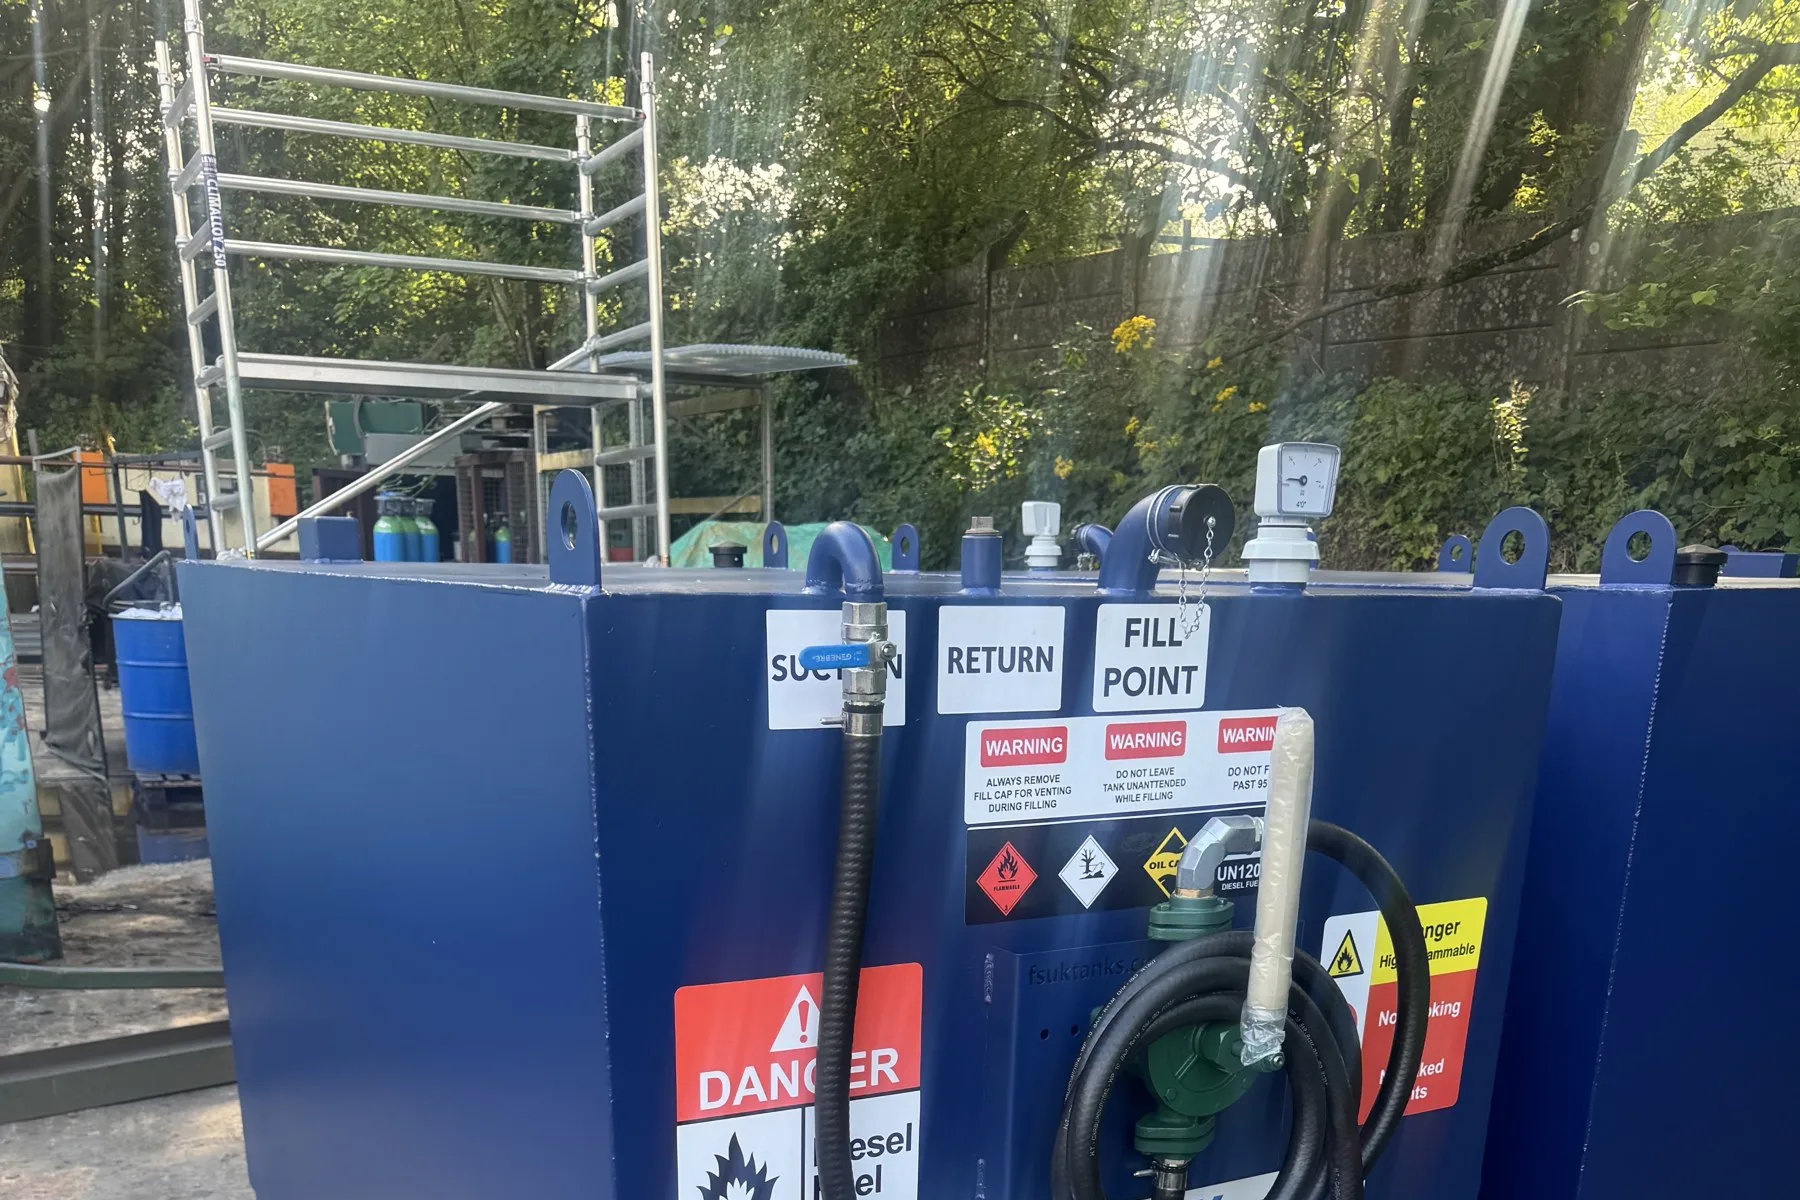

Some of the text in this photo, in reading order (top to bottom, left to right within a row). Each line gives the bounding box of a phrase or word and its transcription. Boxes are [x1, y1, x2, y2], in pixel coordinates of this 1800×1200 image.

[206, 179, 224, 242] CLIMALLOY
[213, 244, 226, 267] 250
[1124, 617, 1182, 648] FILL
[948, 645, 1054, 675] RETURN
[1103, 665, 1199, 698] POINT
[1110, 730, 1182, 750] WARNING
[1222, 726, 1276, 743] WARNIN
[985, 737, 1063, 757] WARNING
[986, 774, 1060, 787] ALWAYS REMOVE
[1116, 767, 1175, 779] DO NOT LEAVE
[1228, 766, 1241, 777] DO
[1243, 765, 1262, 775] NOT
[974, 786, 1072, 800] FILL CAP FOR VENTING
[1103, 782, 1125, 792] TANK
[1233, 779, 1268, 790] PAST 95
[988, 799, 1057, 812] DURING FILLING
[1115, 791, 1173, 803] WHILE FILLING
[1149, 860, 1166, 870] OIL
[1217, 863, 1260, 881] UN120
[1221, 880, 1259, 891] DIESEL FUE
[1422, 920, 1461, 942] nger
[1379, 942, 1475, 969] Hig ammable
[1029, 957, 1147, 985] fsuktanks.c
[1378, 1001, 1461, 1027] No king
[1417, 1058, 1445, 1077] ked
[699, 1047, 900, 1111] DANER
[814, 1122, 912, 1167] esel
